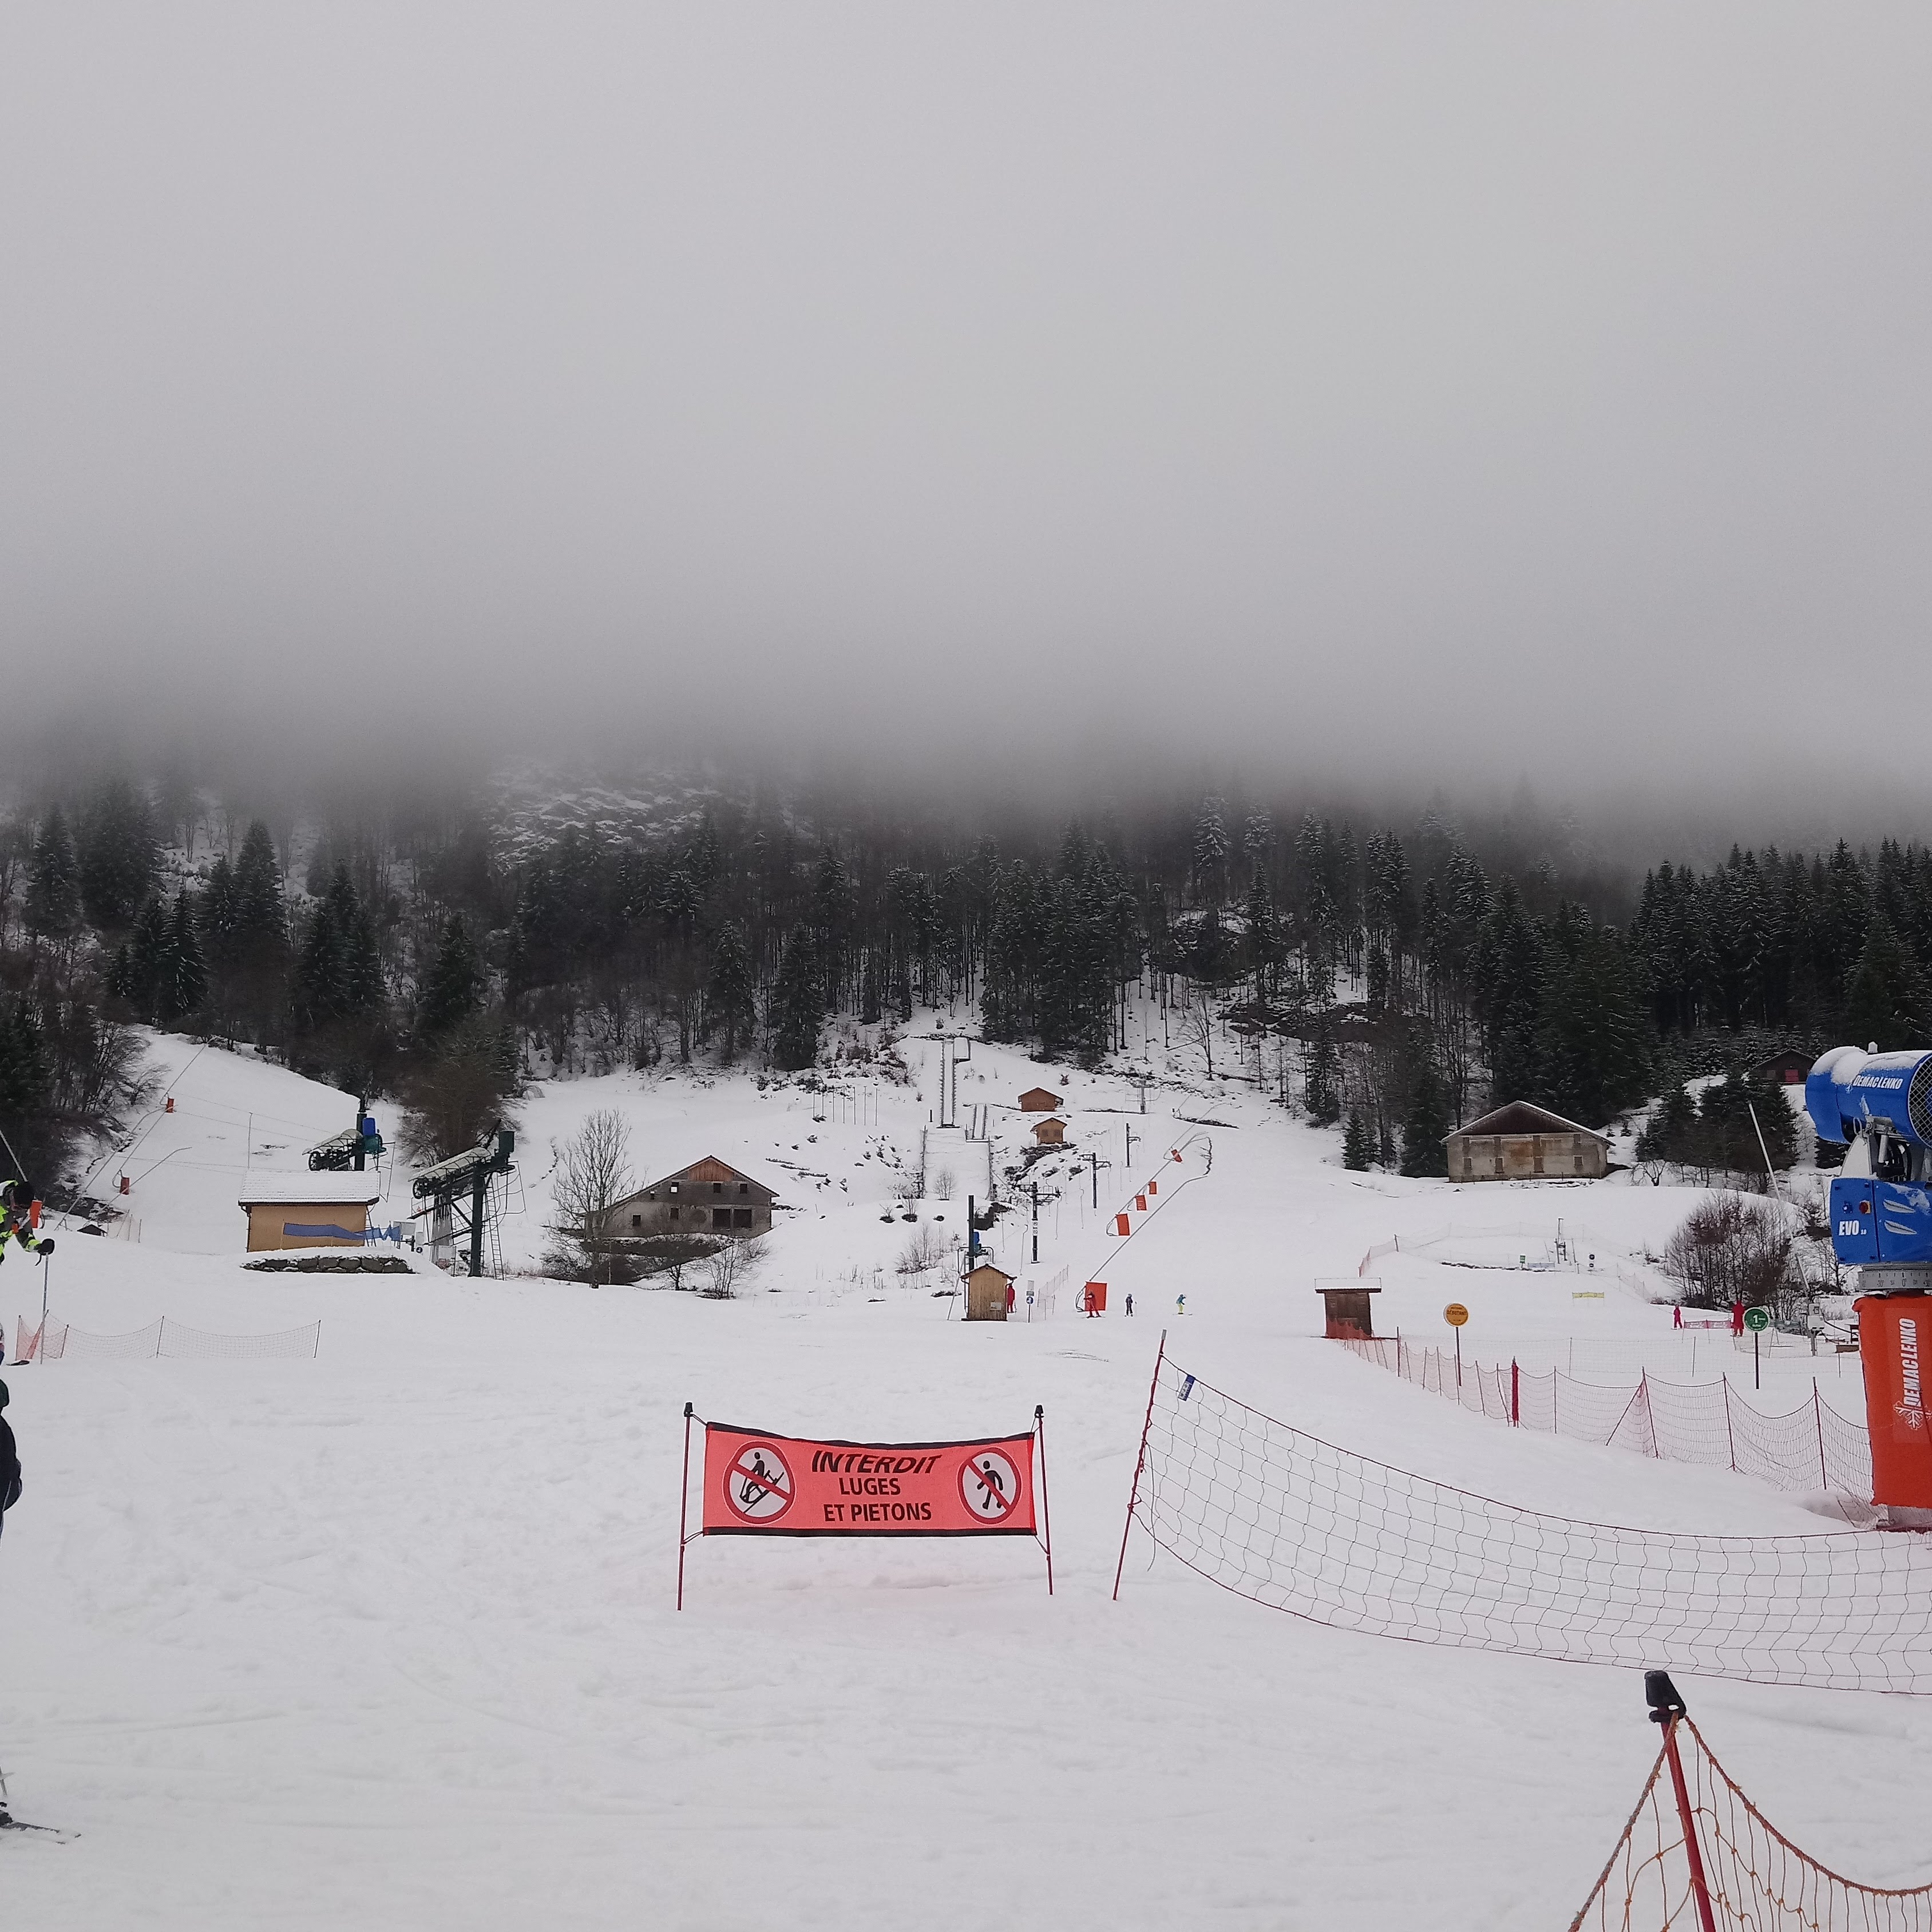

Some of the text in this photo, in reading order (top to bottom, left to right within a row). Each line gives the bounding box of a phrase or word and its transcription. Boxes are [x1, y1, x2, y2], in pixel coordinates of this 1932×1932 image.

[1852, 1075, 1904, 1090] DEMACLENKO
[1838, 1220, 1860, 1236] EVO
[1899, 1317, 1922, 1407] DEMACLENKO
[811, 1450, 943, 1474] INTERDIT
[838, 1477, 901, 1495] LUGES
[823, 1502, 932, 1522] ET PIETONS
